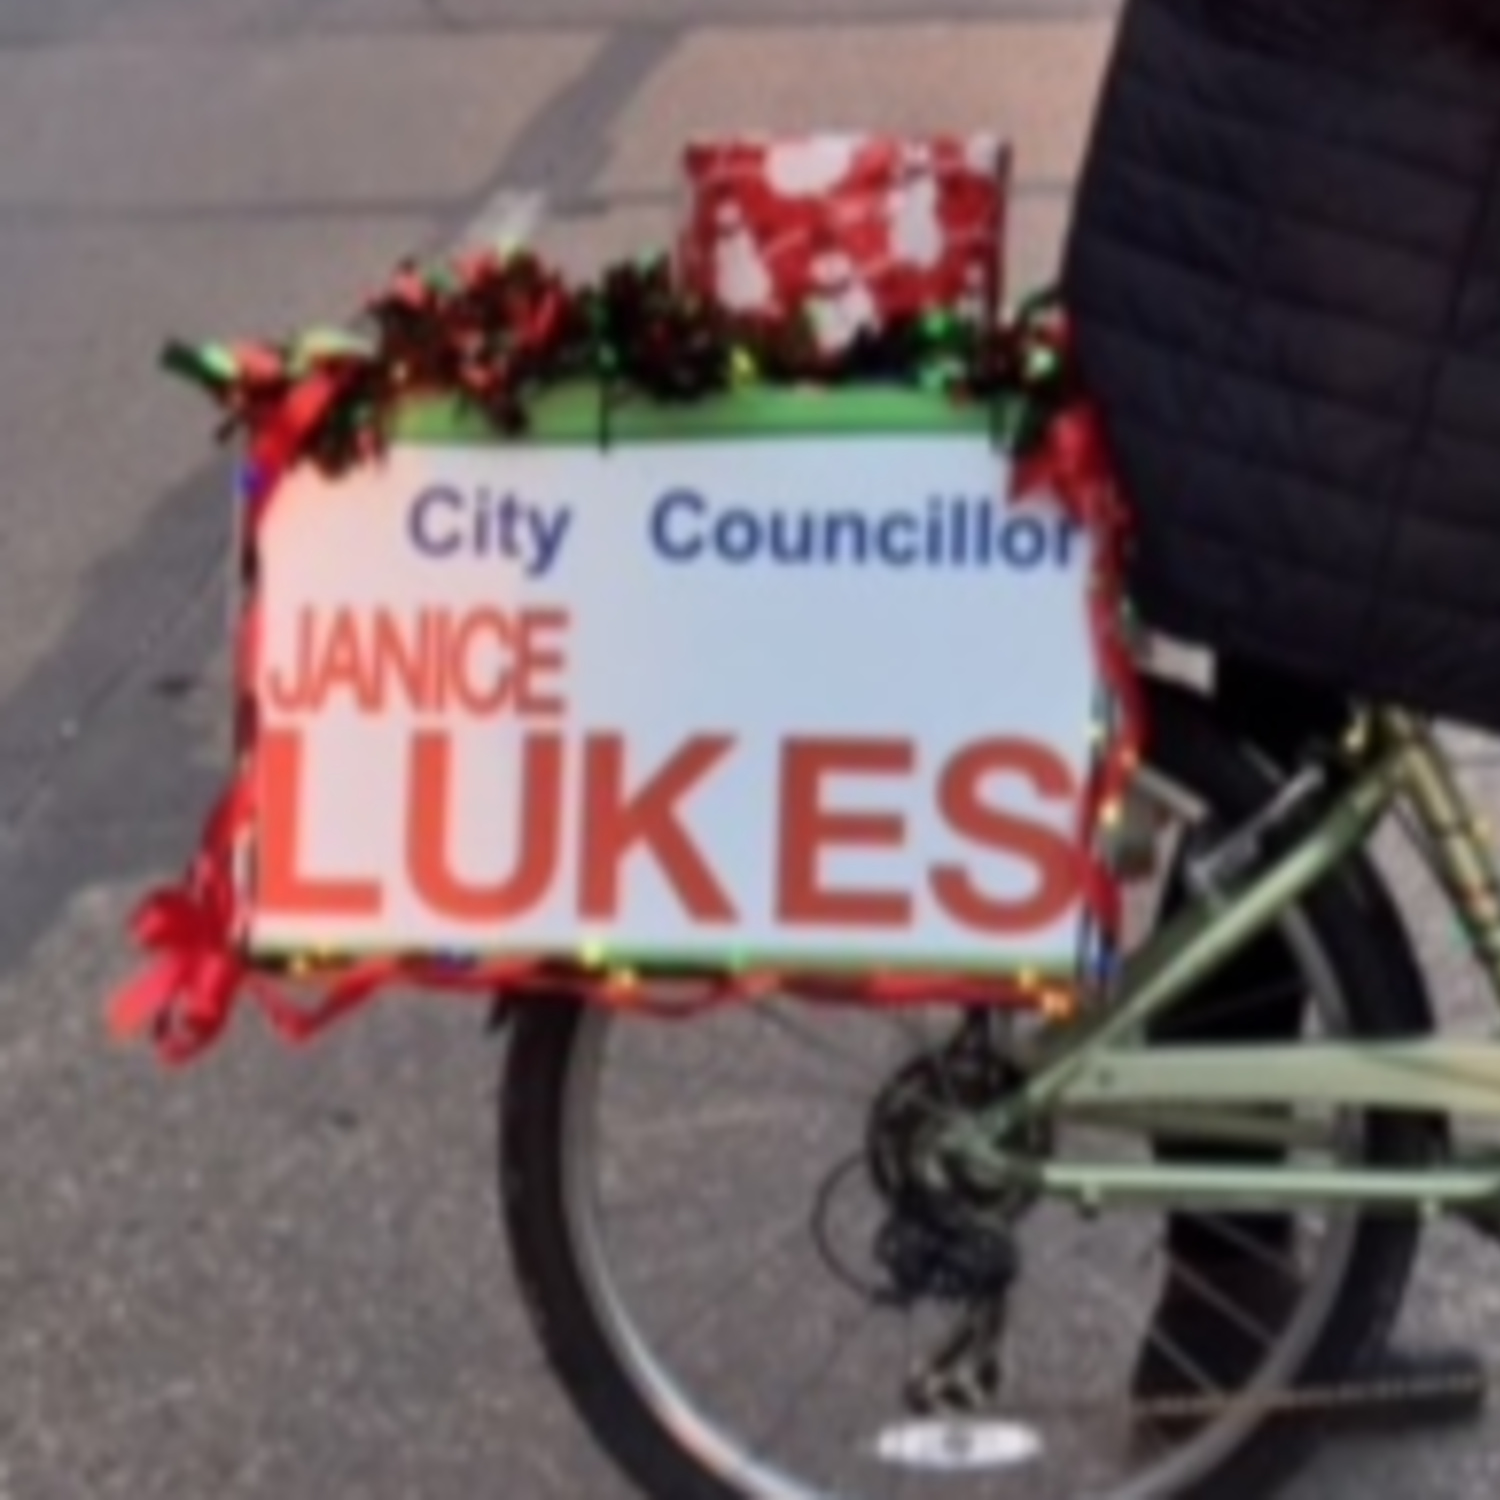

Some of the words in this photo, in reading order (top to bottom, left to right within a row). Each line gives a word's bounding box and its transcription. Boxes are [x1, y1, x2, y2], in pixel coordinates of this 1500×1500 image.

[407, 485, 571, 575] City
[649, 488, 1082, 570] Councillor
[266, 606, 568, 716] JANICE
[254, 729, 1084, 934] LUKES
